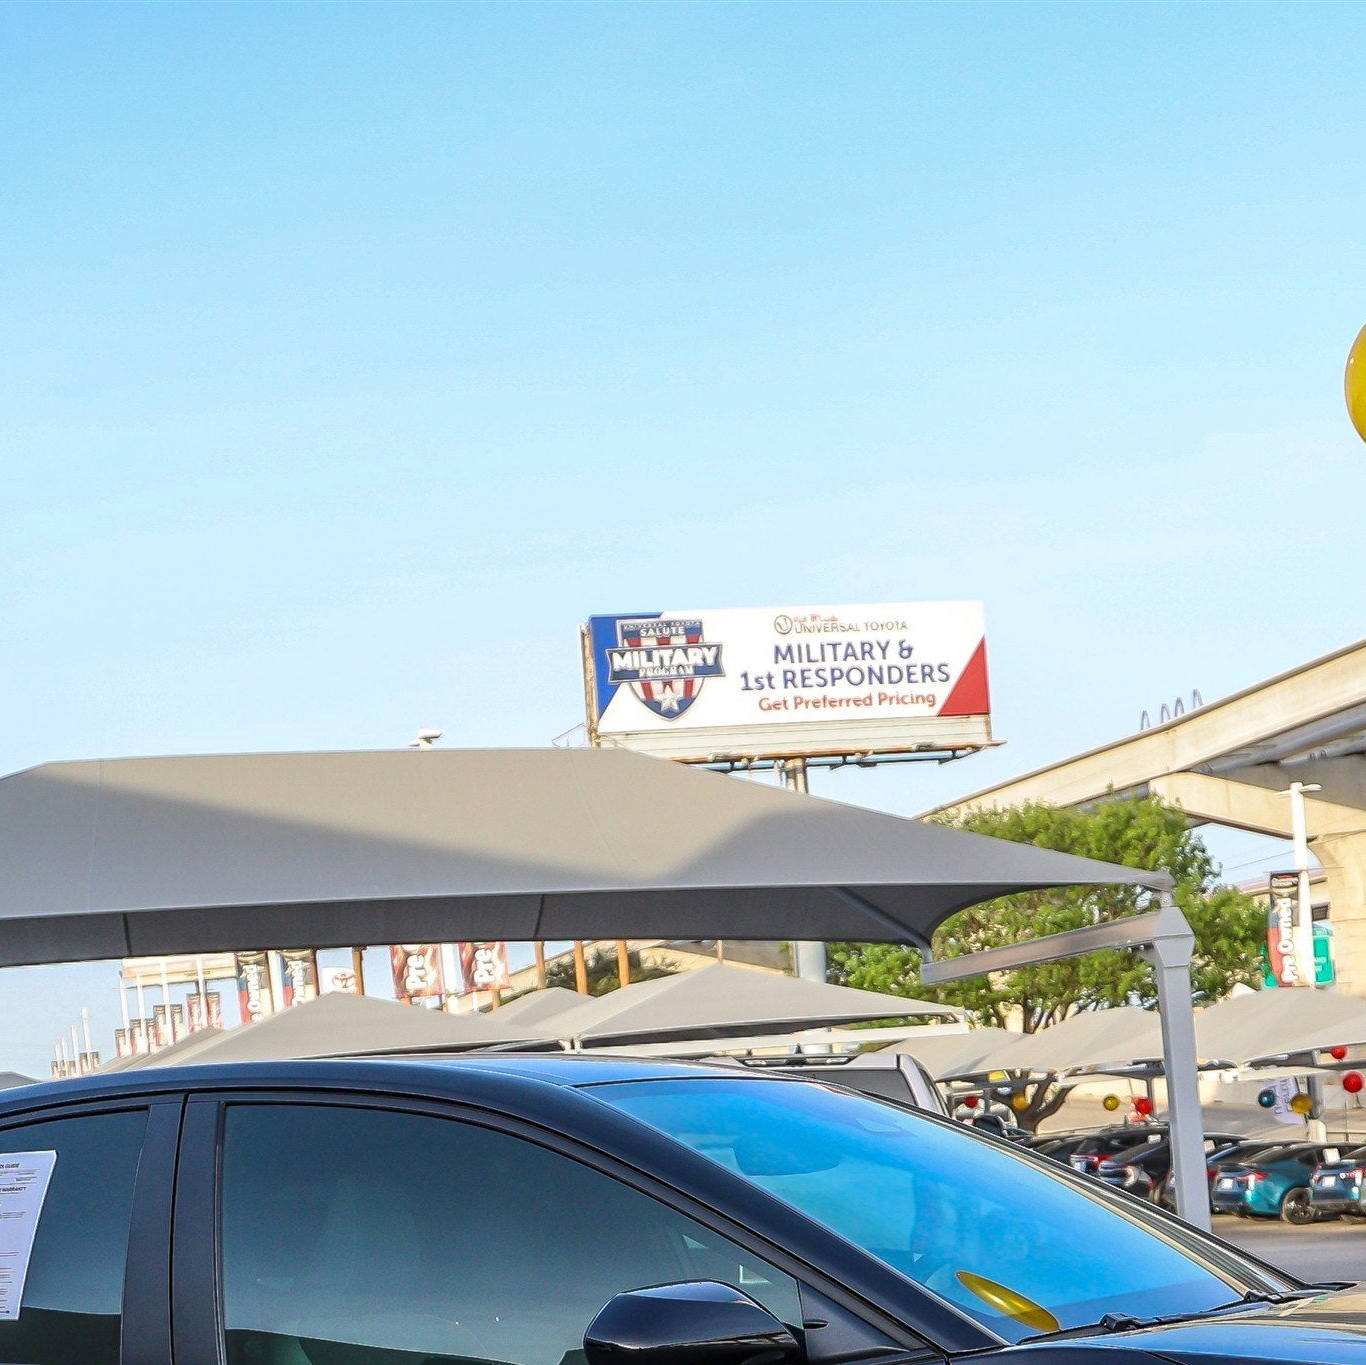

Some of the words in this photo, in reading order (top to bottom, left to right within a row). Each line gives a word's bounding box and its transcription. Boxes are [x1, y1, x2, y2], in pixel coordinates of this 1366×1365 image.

[639, 626, 686, 637] SALUTE
[794, 622, 861, 634] UNIVERSAL
[864, 620, 908, 631] TOYOTA
[612, 645, 718, 672] MILITARY
[773, 639, 890, 665] MILITARY
[898, 638, 914, 660] &
[639, 665, 695, 677] PROGRAM
[740, 671, 775, 691] 1st
[783, 662, 951, 690] RESPONDERS
[758, 697, 790, 711] Get
[793, 694, 874, 710] Preferred
[878, 692, 937, 708] Pricing
[405, 953, 428, 991] Pre
[473, 949, 496, 985] Pre
